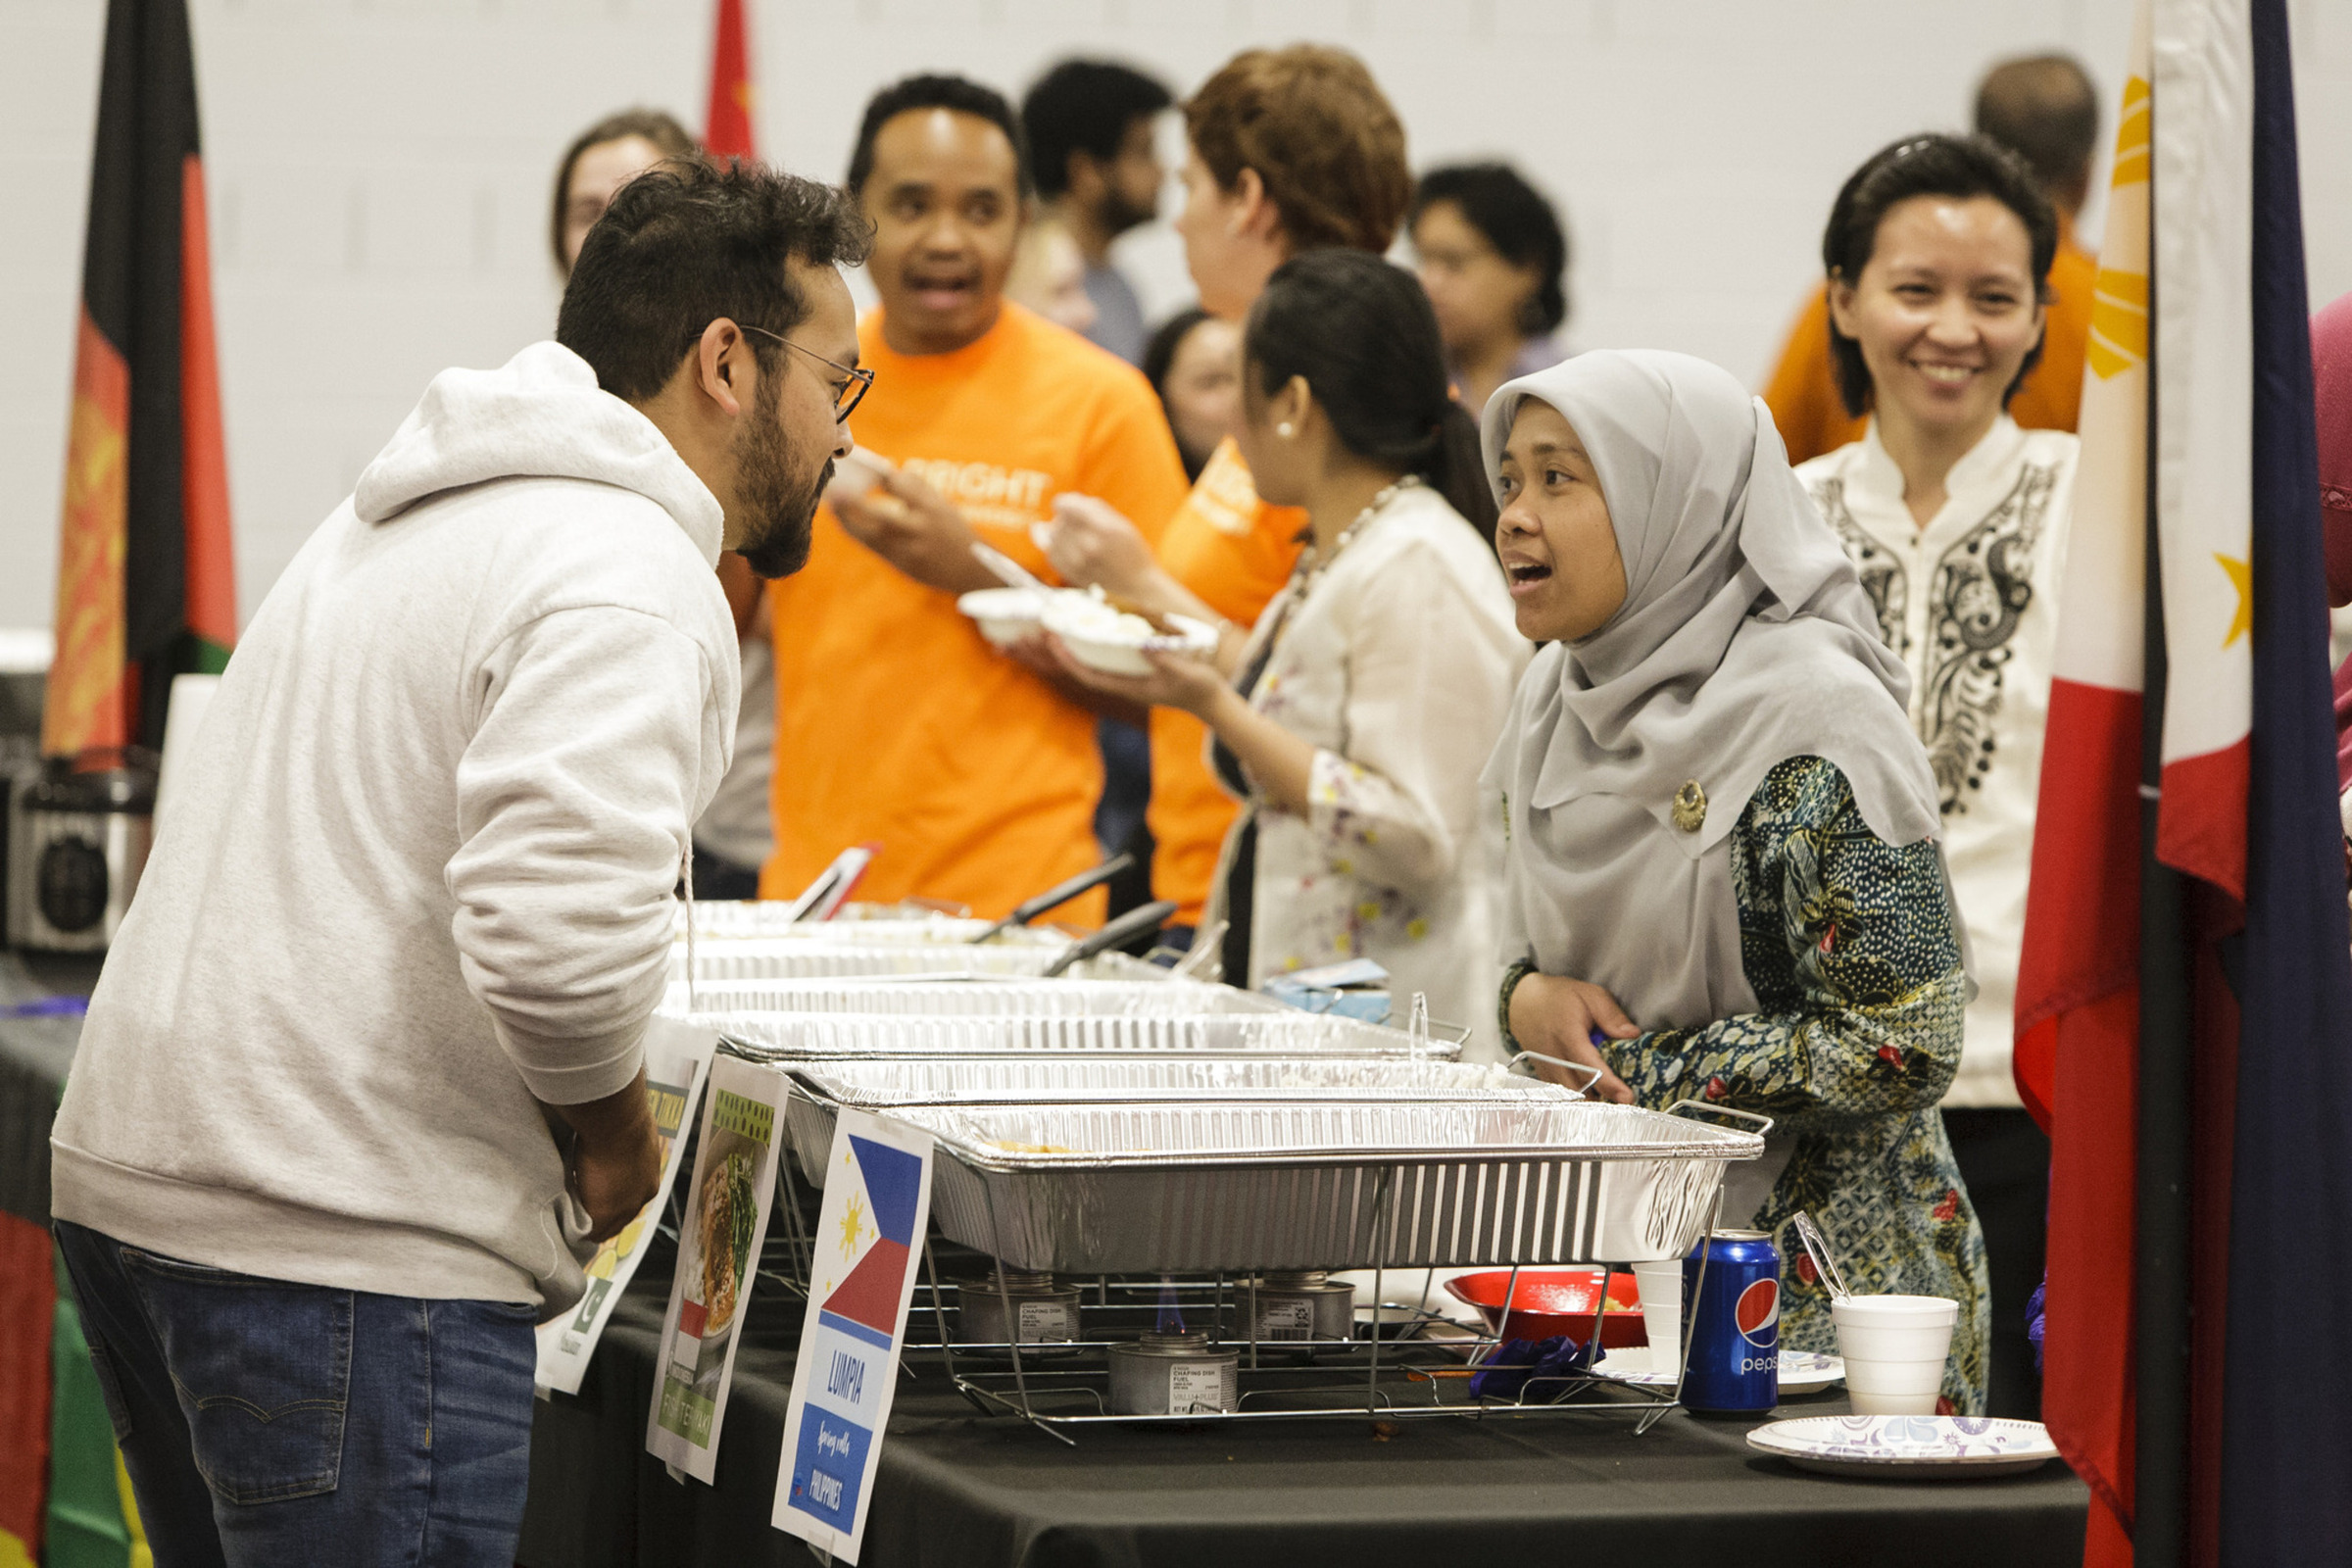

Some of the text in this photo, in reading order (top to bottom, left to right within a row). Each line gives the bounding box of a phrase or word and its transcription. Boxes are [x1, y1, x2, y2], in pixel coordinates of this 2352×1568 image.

[827, 1349, 865, 1405] LUMPIA
[836, 1432, 850, 1458] rolls
[808, 1469, 843, 1511] PHILIPPINES
